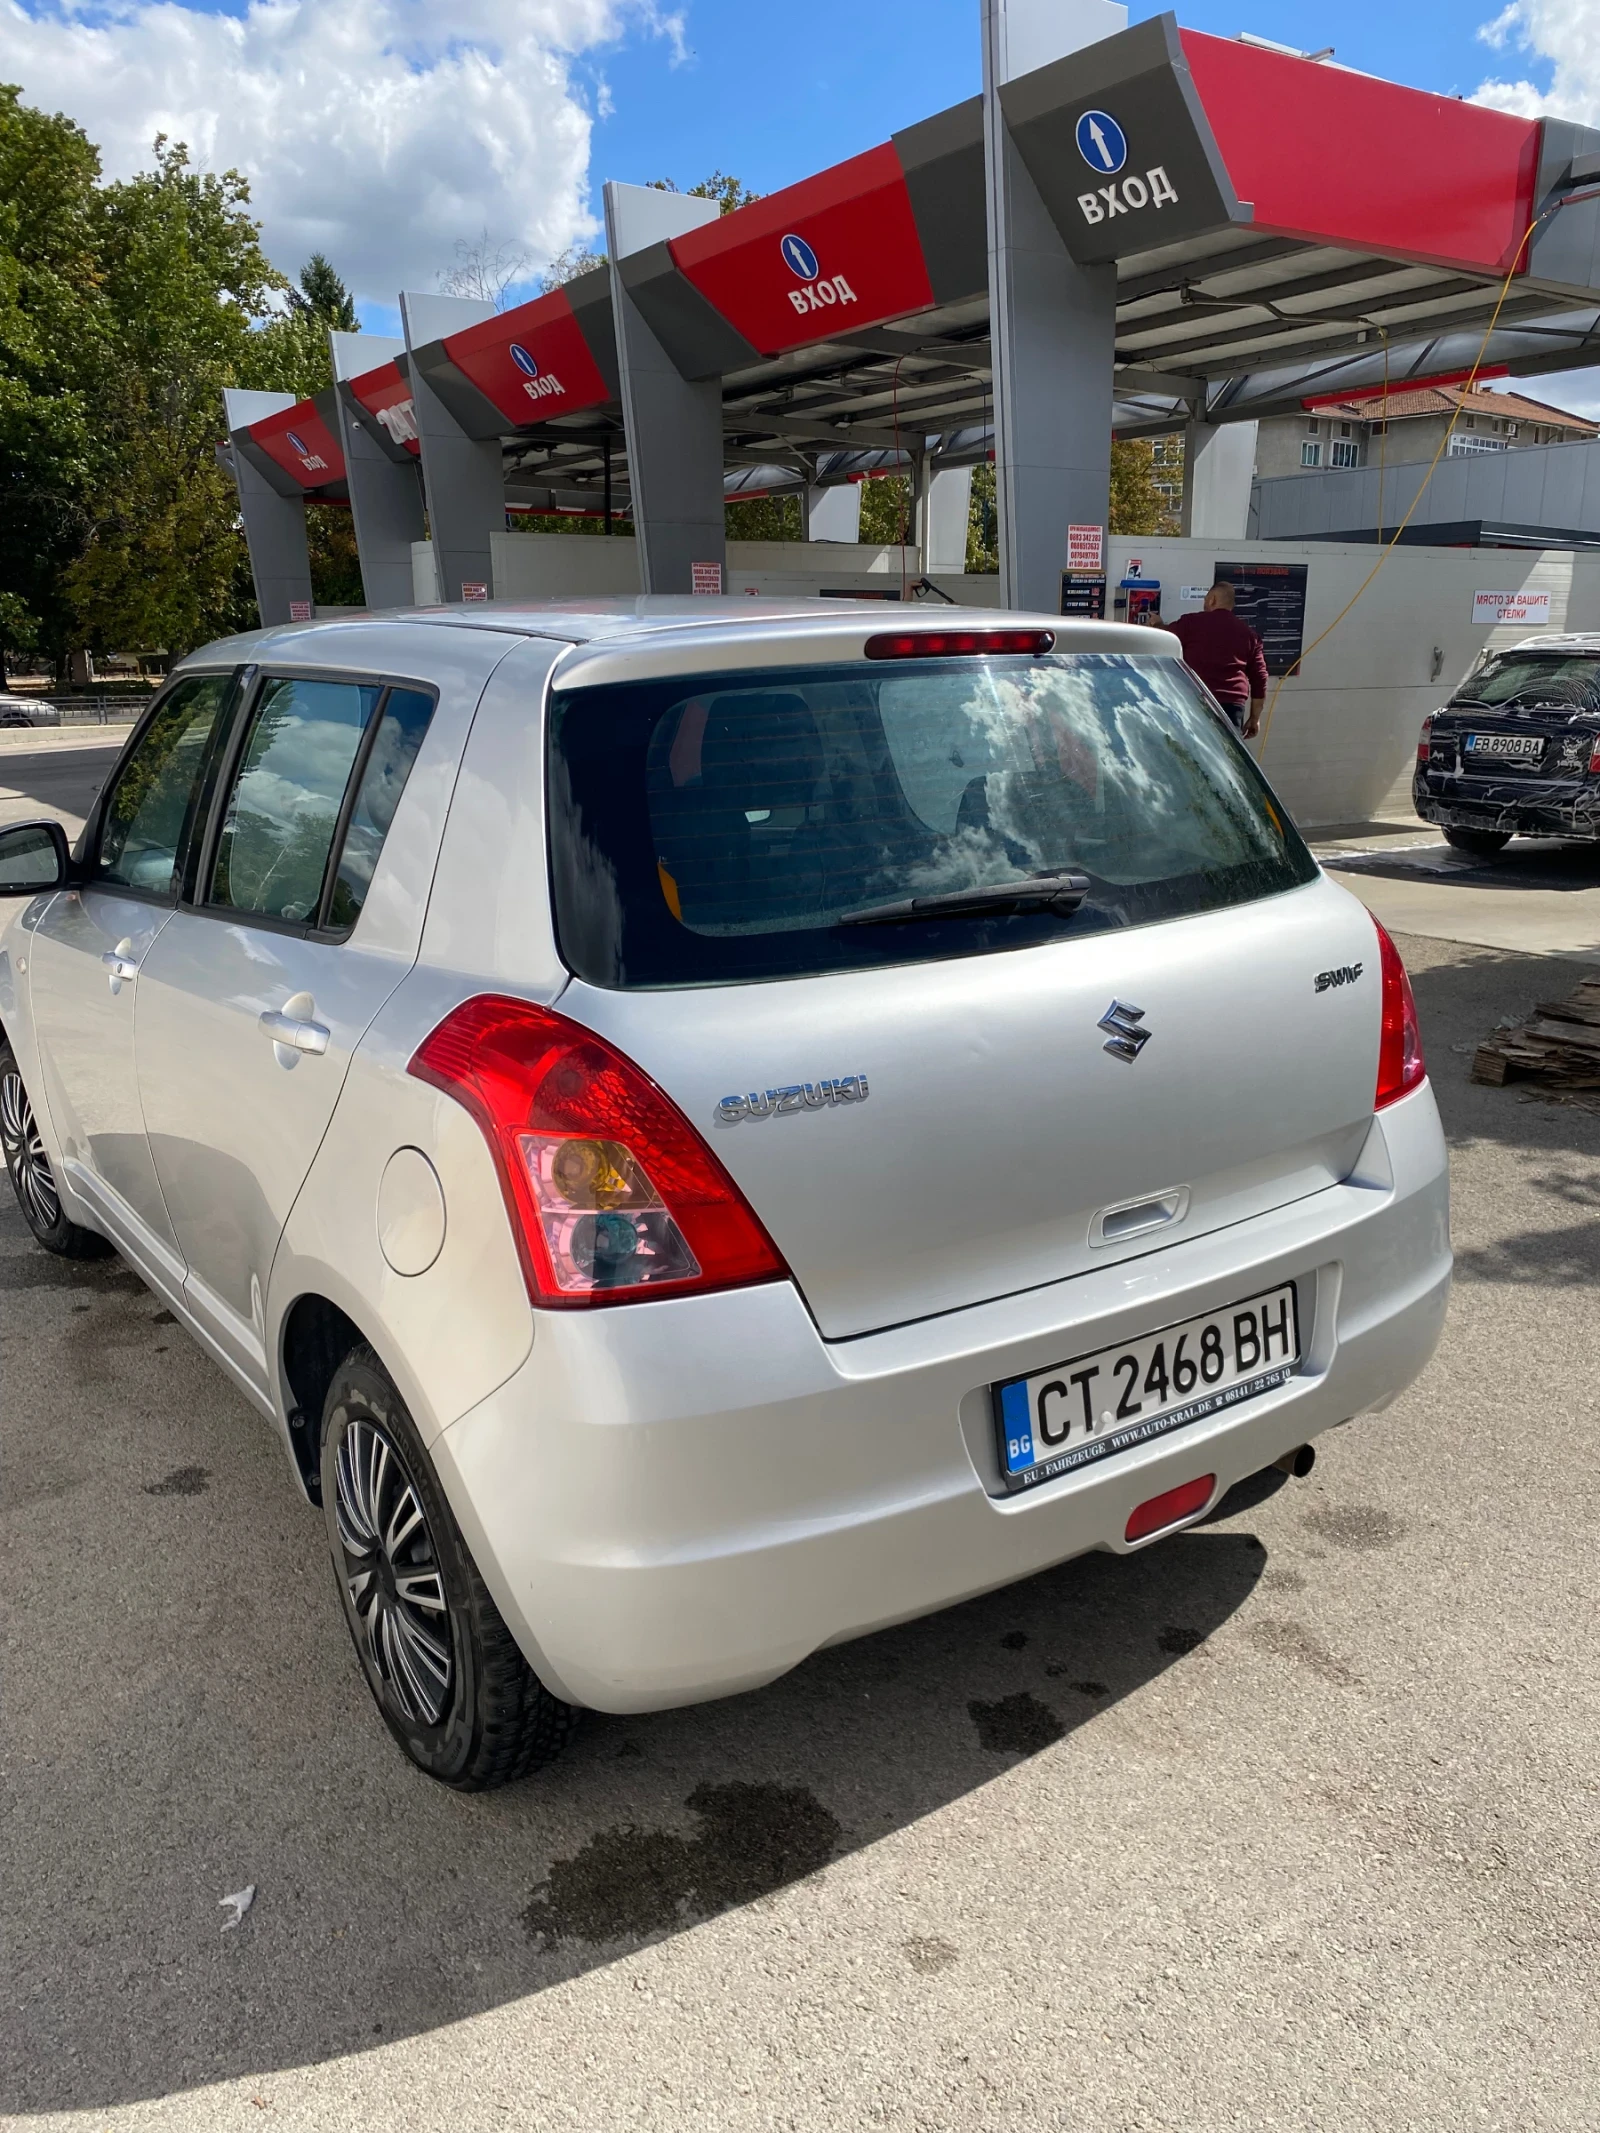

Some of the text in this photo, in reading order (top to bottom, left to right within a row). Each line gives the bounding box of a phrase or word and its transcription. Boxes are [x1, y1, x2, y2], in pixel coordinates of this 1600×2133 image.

[1077, 166, 1179, 225] ВХОД
[788, 274, 858, 315] ВХОД
[522, 373, 566, 400] ВХОД
[301, 455, 329, 471] ВХОД
[1476, 595, 1548, 605] МЯСТО ЗА ВАШИТЕ
[1497, 609, 1526, 619] СТЕЛКИ
[1474, 738, 1539, 753] EB 8908 BA
[719, 1073, 870, 1122] SUZUKI
[1037, 1298, 1290, 1447] CT 2468 BH
[1023, 1471, 1039, 1484] EU
[1045, 1442, 1106, 1476] FAHRZEUGE
[1225, 1385, 1248, 1402] 08141
[1254, 1380, 1265, 1390] 22
[1266, 1376, 1280, 1386] 765
[1281, 1368, 1291, 1380] 10
[1008, 1434, 1031, 1459] BG
